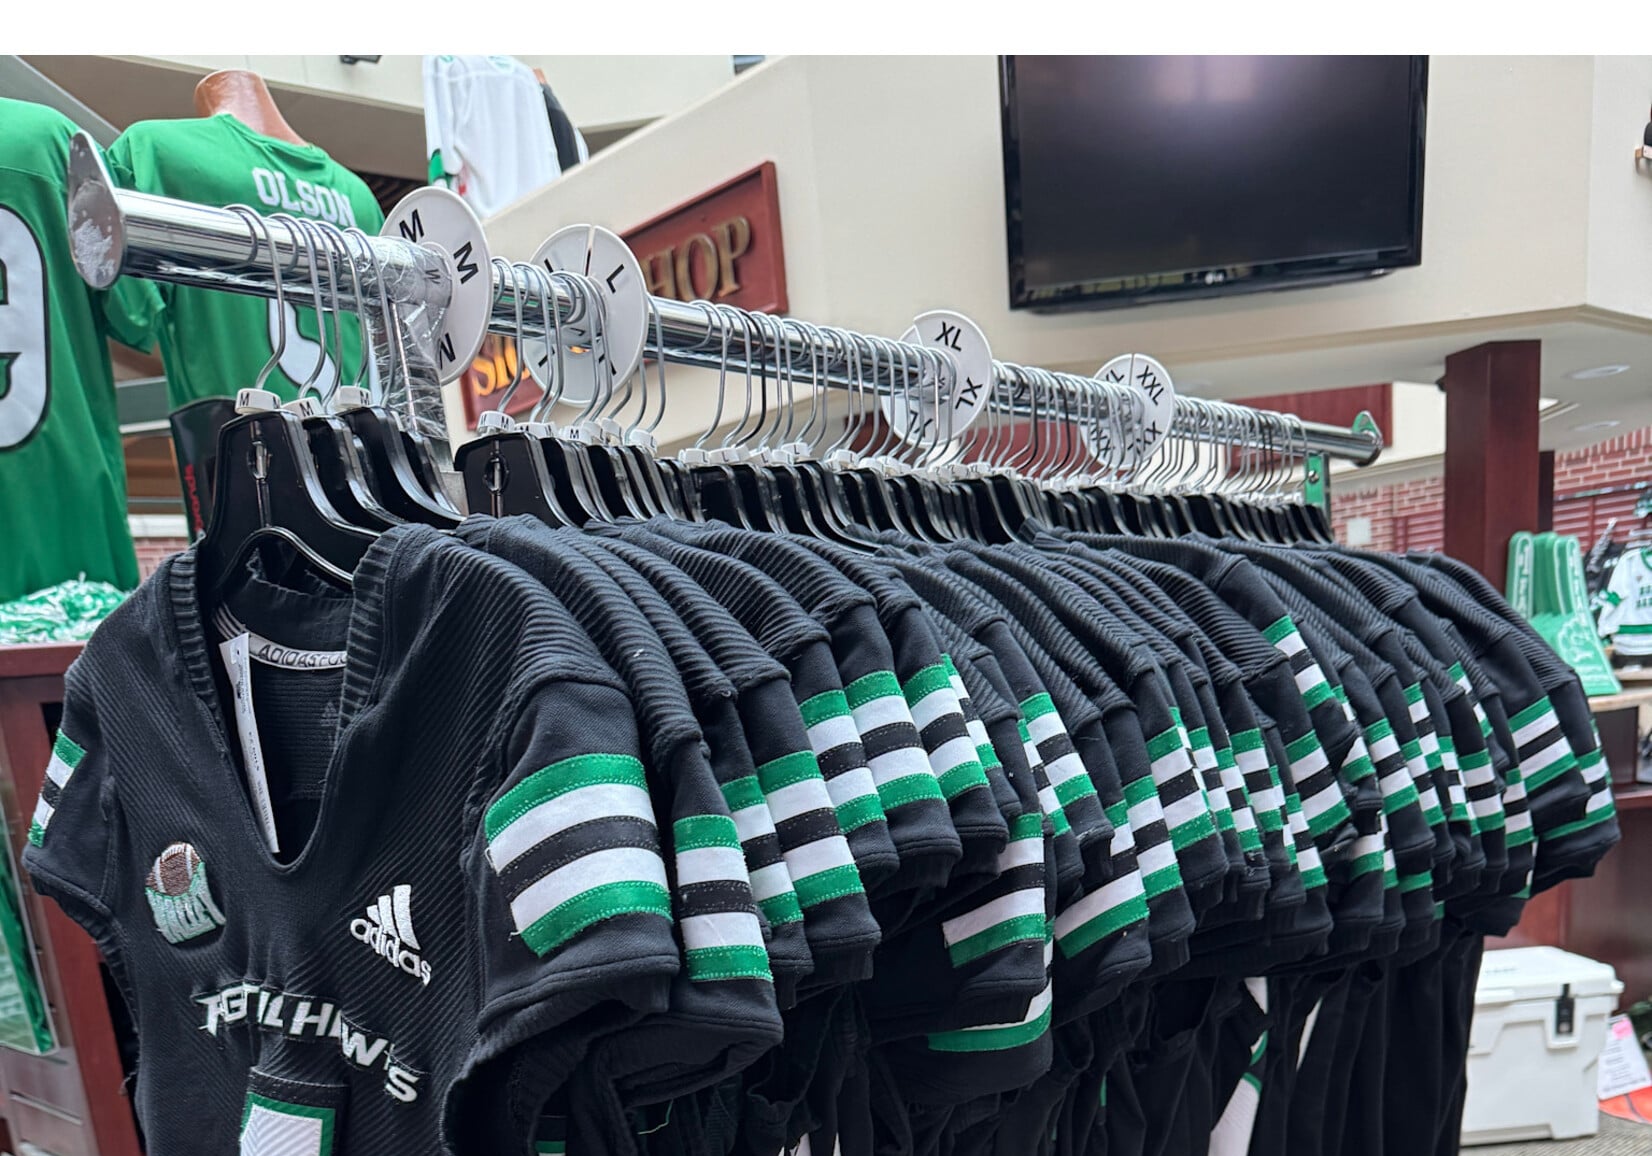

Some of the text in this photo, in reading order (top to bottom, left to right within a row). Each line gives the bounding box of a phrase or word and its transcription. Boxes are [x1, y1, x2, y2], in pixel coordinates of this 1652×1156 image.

[252, 167, 357, 228] OLSON
[399, 208, 425, 244] M
[453, 240, 480, 285] M
[639, 215, 751, 300] HOP
[606, 264, 625, 294] L
[935, 321, 962, 352] XL
[240, 391, 250, 406] M
[359, 390, 370, 406] M
[954, 377, 984, 410] XL
[1136, 364, 1165, 407] XXL
[300, 402, 314, 418] M
[569, 428, 580, 440] M
[794, 444, 801, 456] L
[350, 918, 432, 987] adidas
